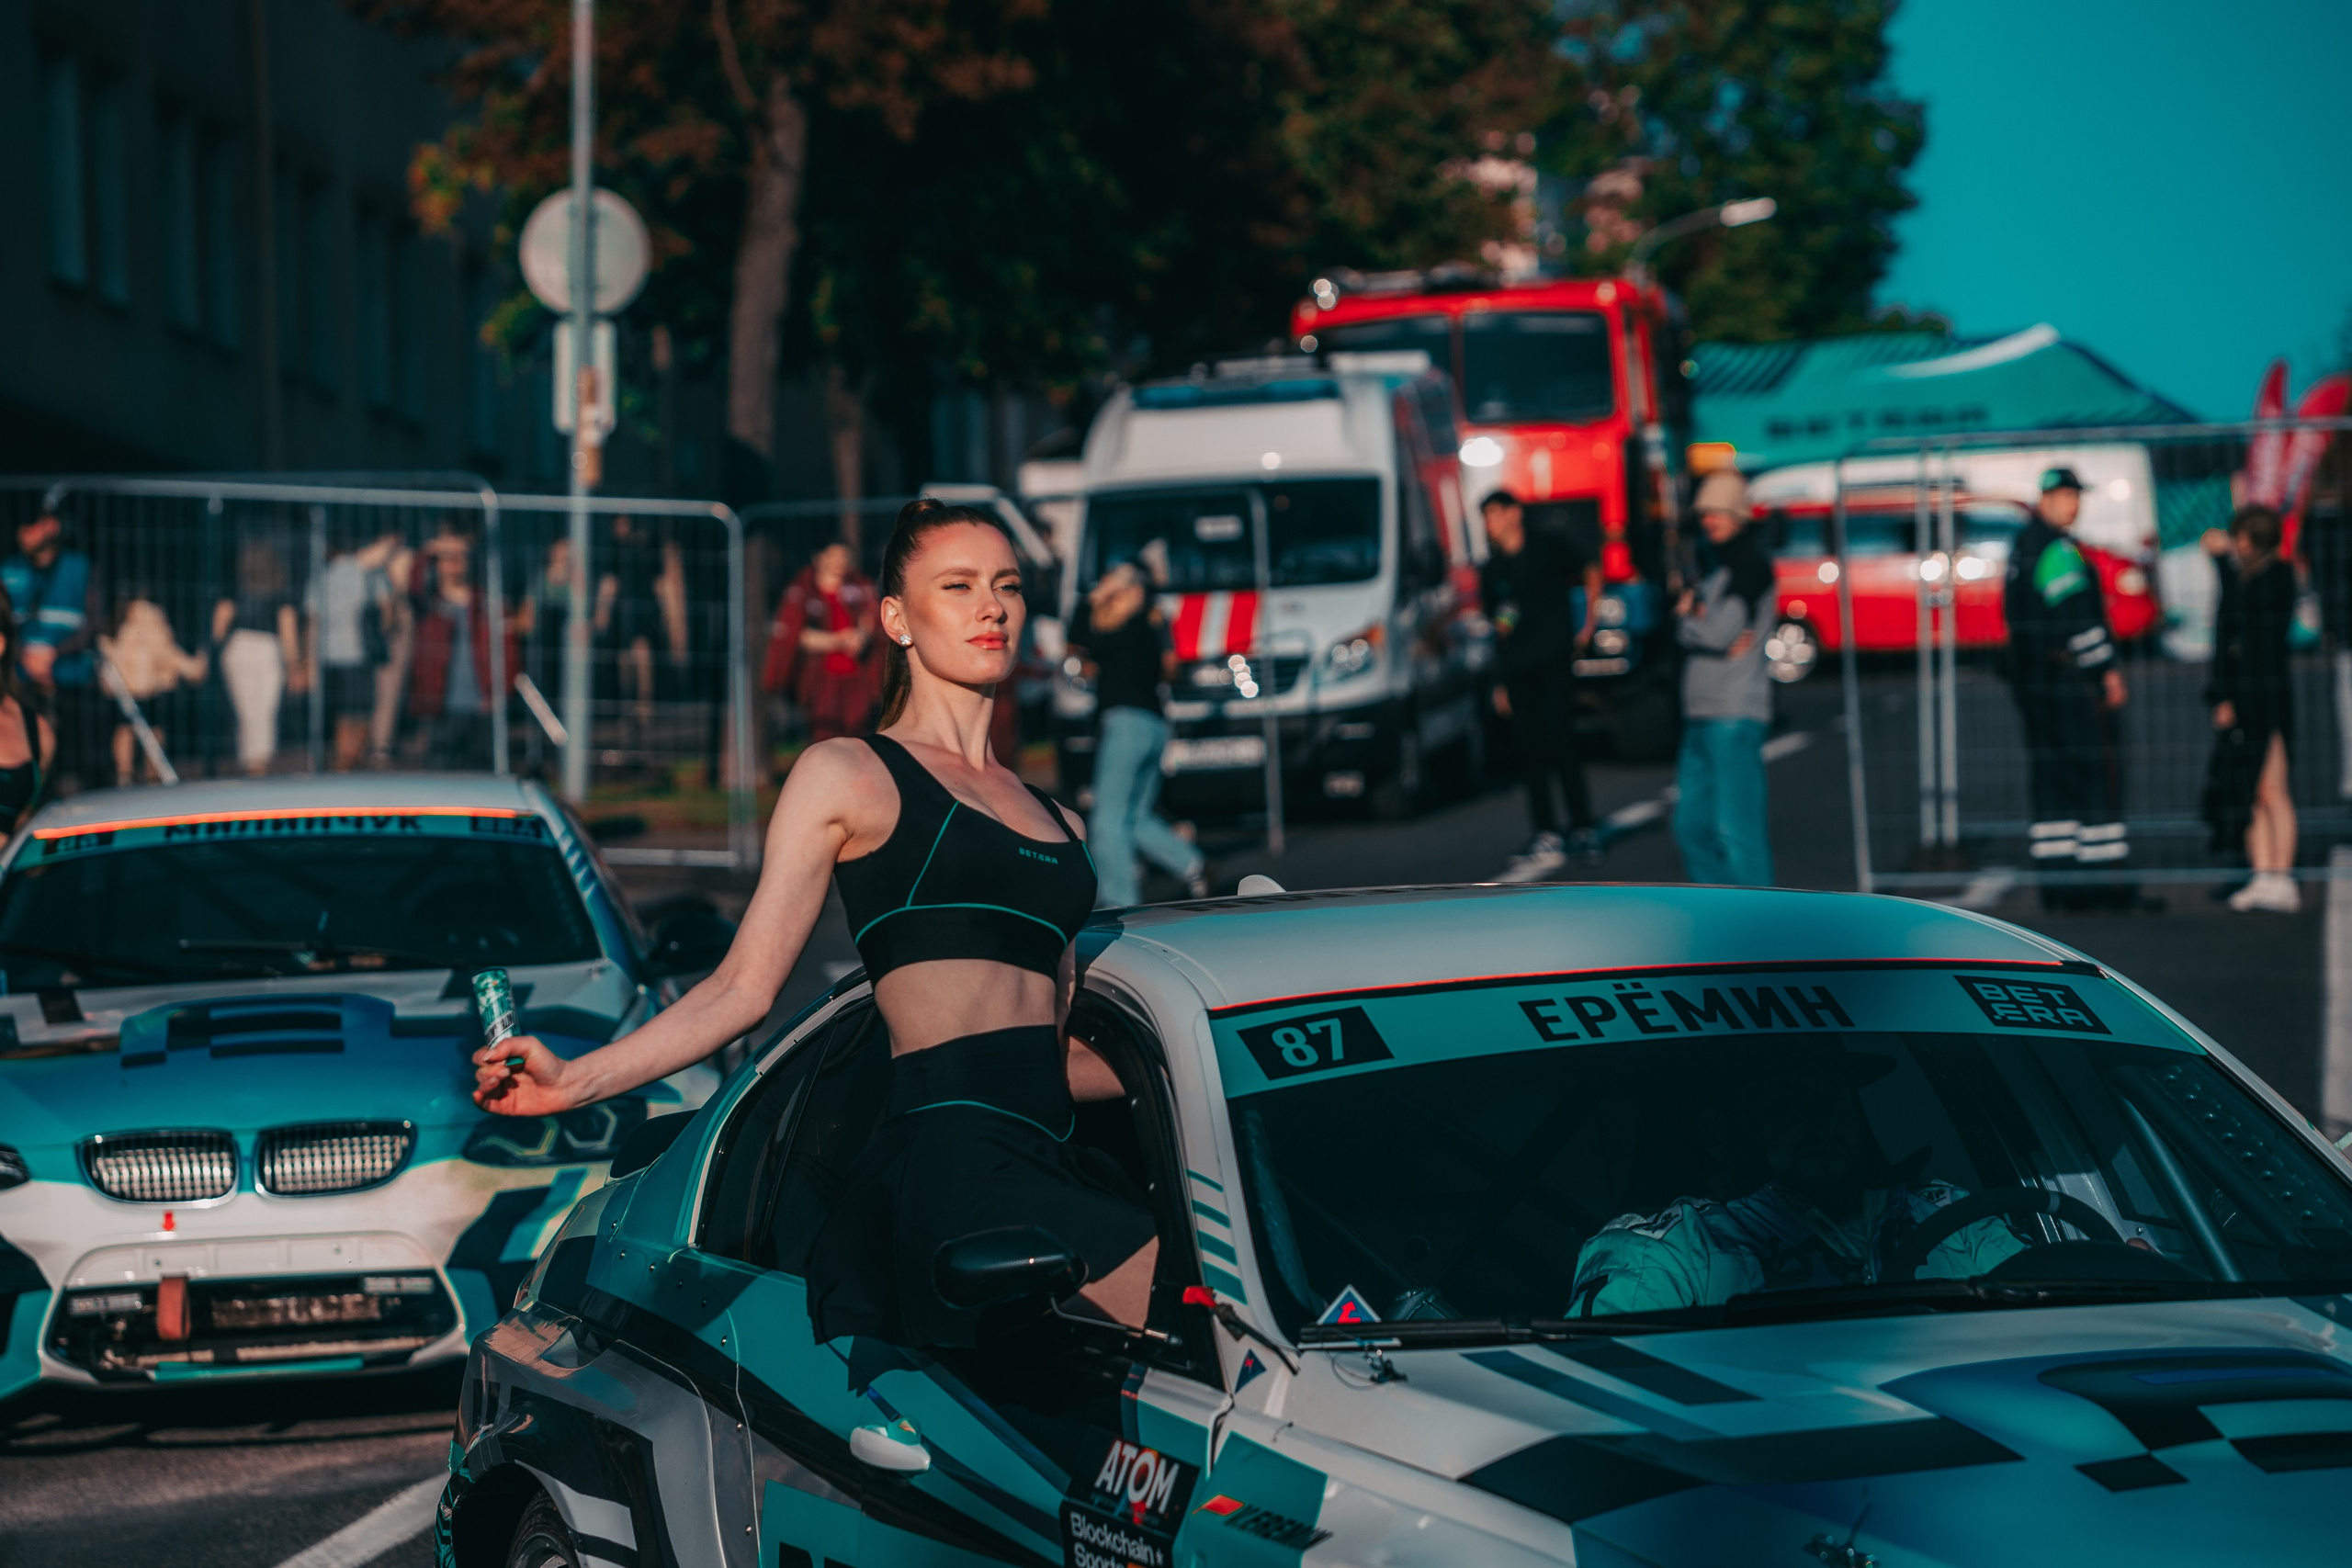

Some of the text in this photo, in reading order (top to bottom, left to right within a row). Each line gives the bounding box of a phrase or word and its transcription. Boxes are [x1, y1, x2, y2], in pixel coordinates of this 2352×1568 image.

[1518, 982, 1856, 1043] ЕРЁМИН
[1973, 983, 2067, 1006] BET
[1991, 1002, 2095, 1027] ERA
[1272, 1017, 1344, 1067] 87
[1093, 1439, 1181, 1514] ATOM
[1070, 1511, 1155, 1566] Blockchain
